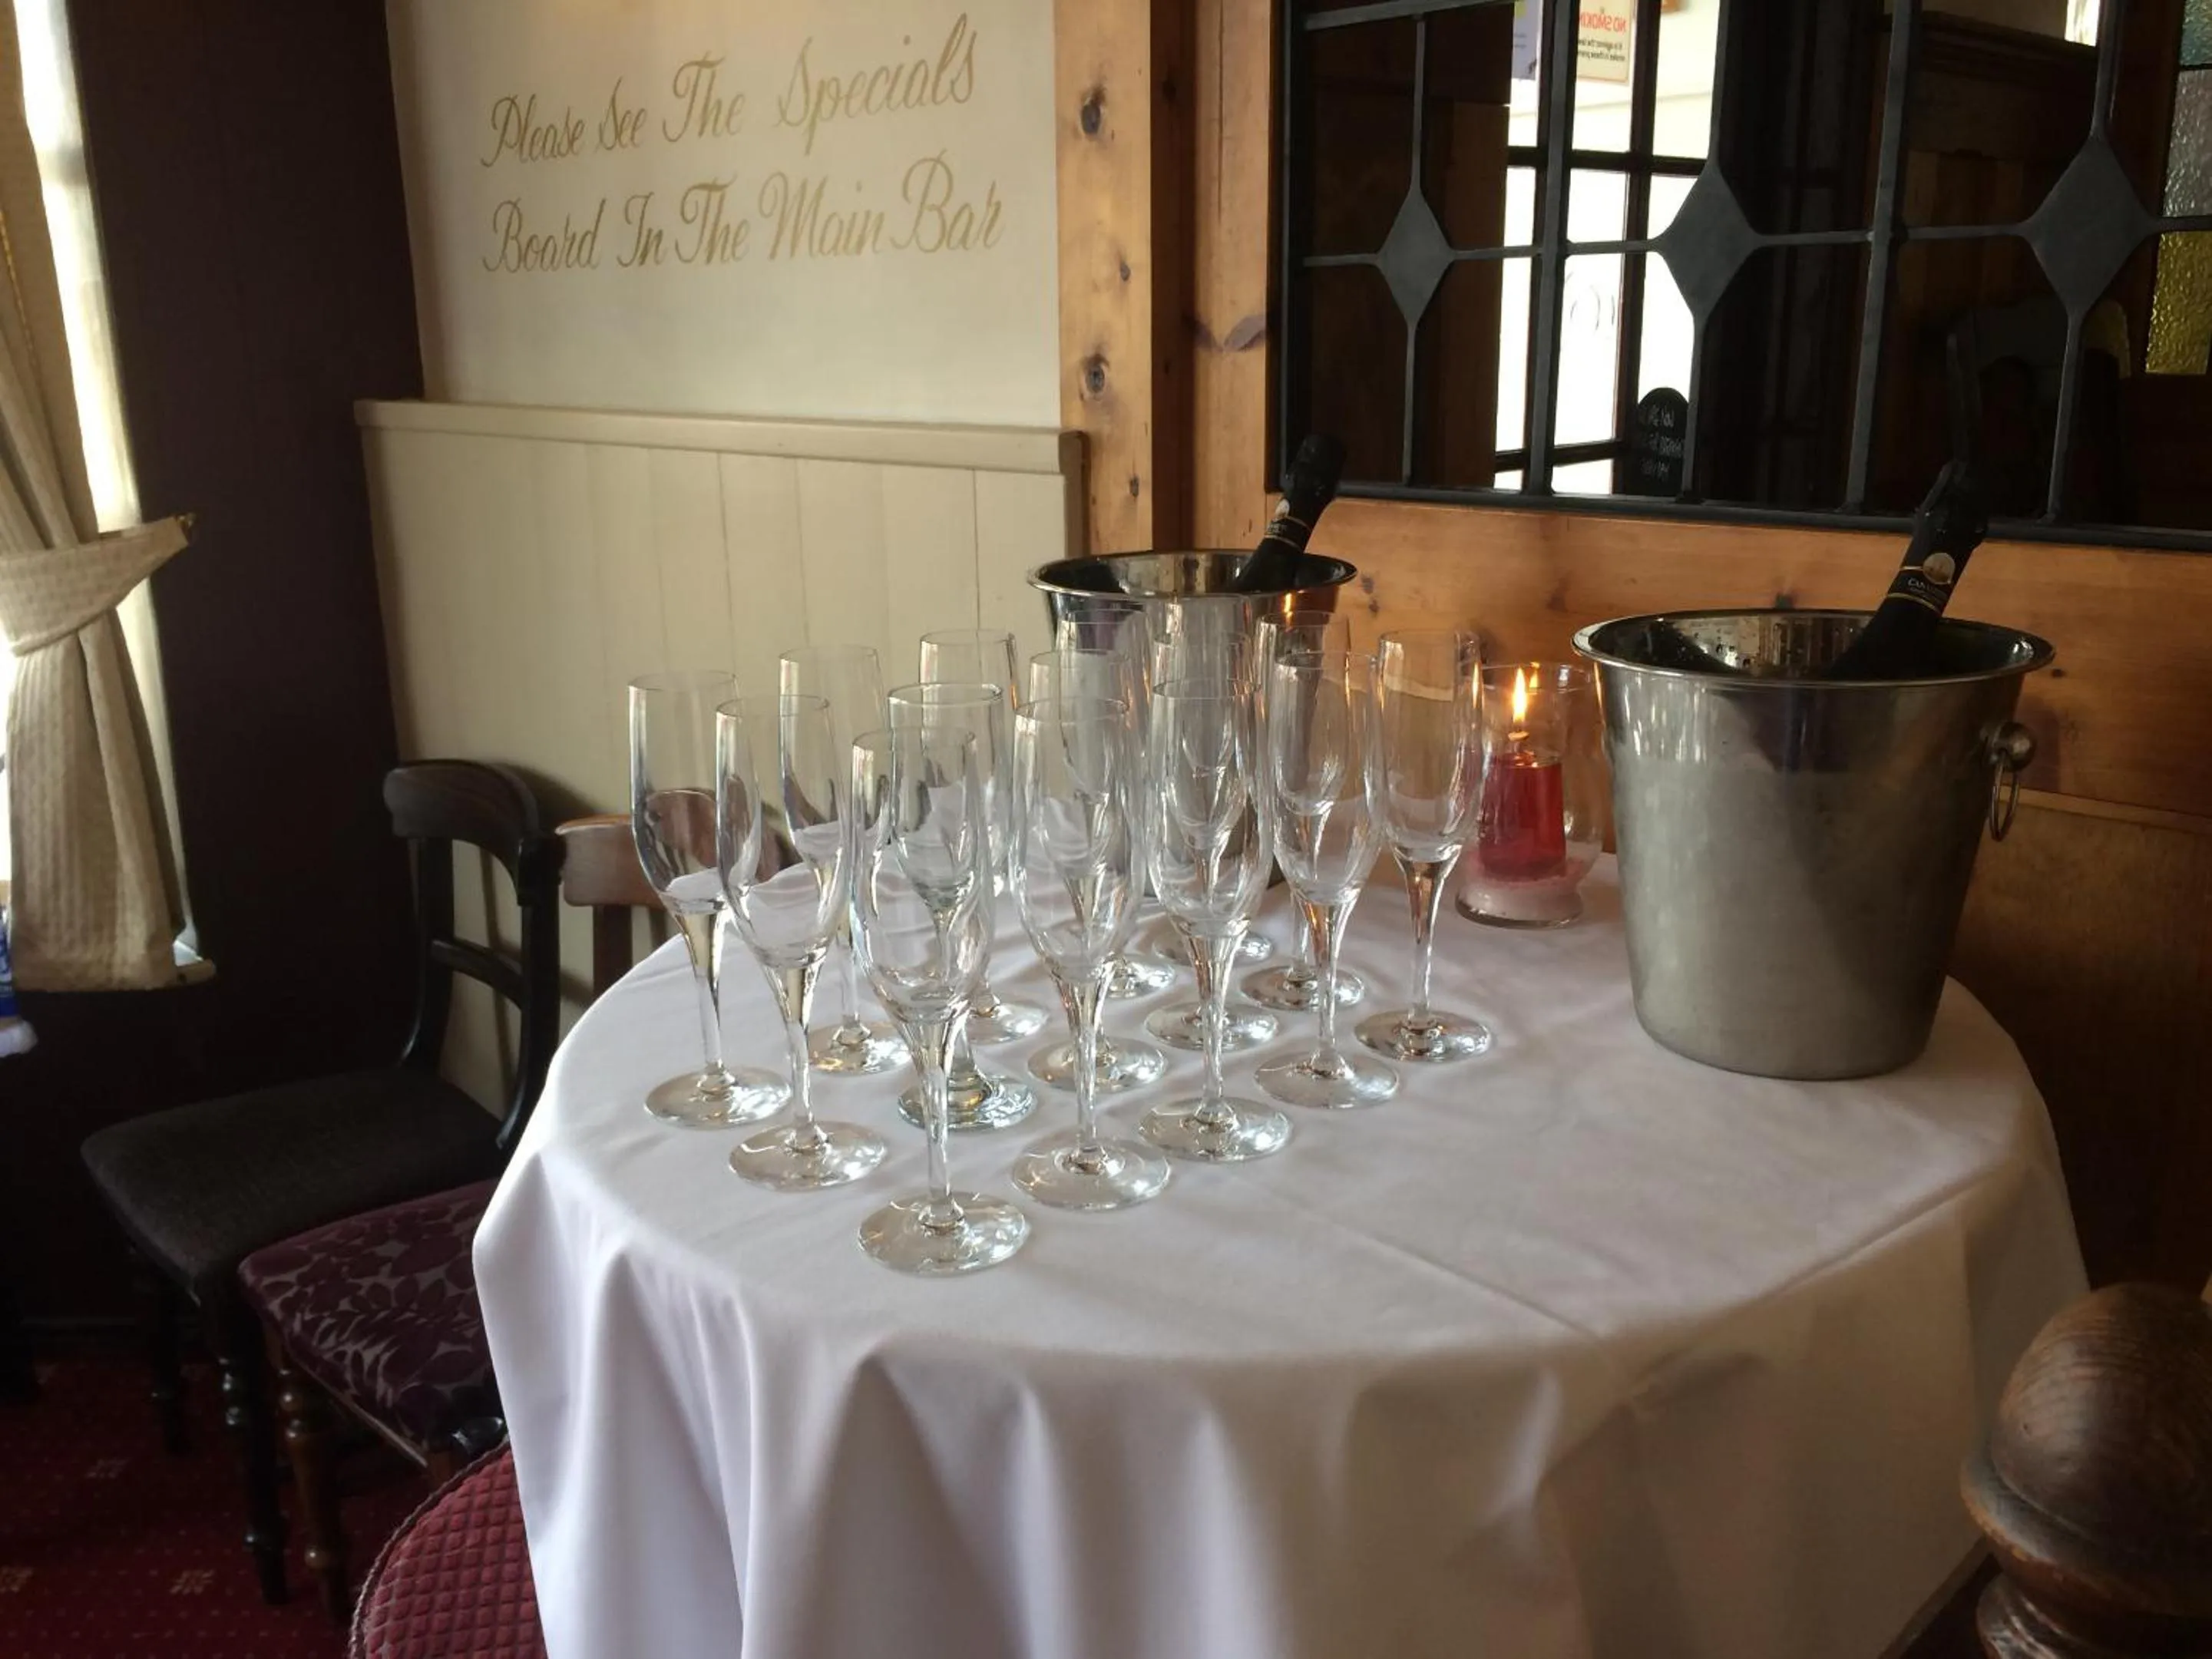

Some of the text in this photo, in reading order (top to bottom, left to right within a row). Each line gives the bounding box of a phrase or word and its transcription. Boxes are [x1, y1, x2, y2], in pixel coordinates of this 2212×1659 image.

[481, 12, 977, 167] Please See The Specials
[482, 149, 1006, 273] Board In The Main Bar
